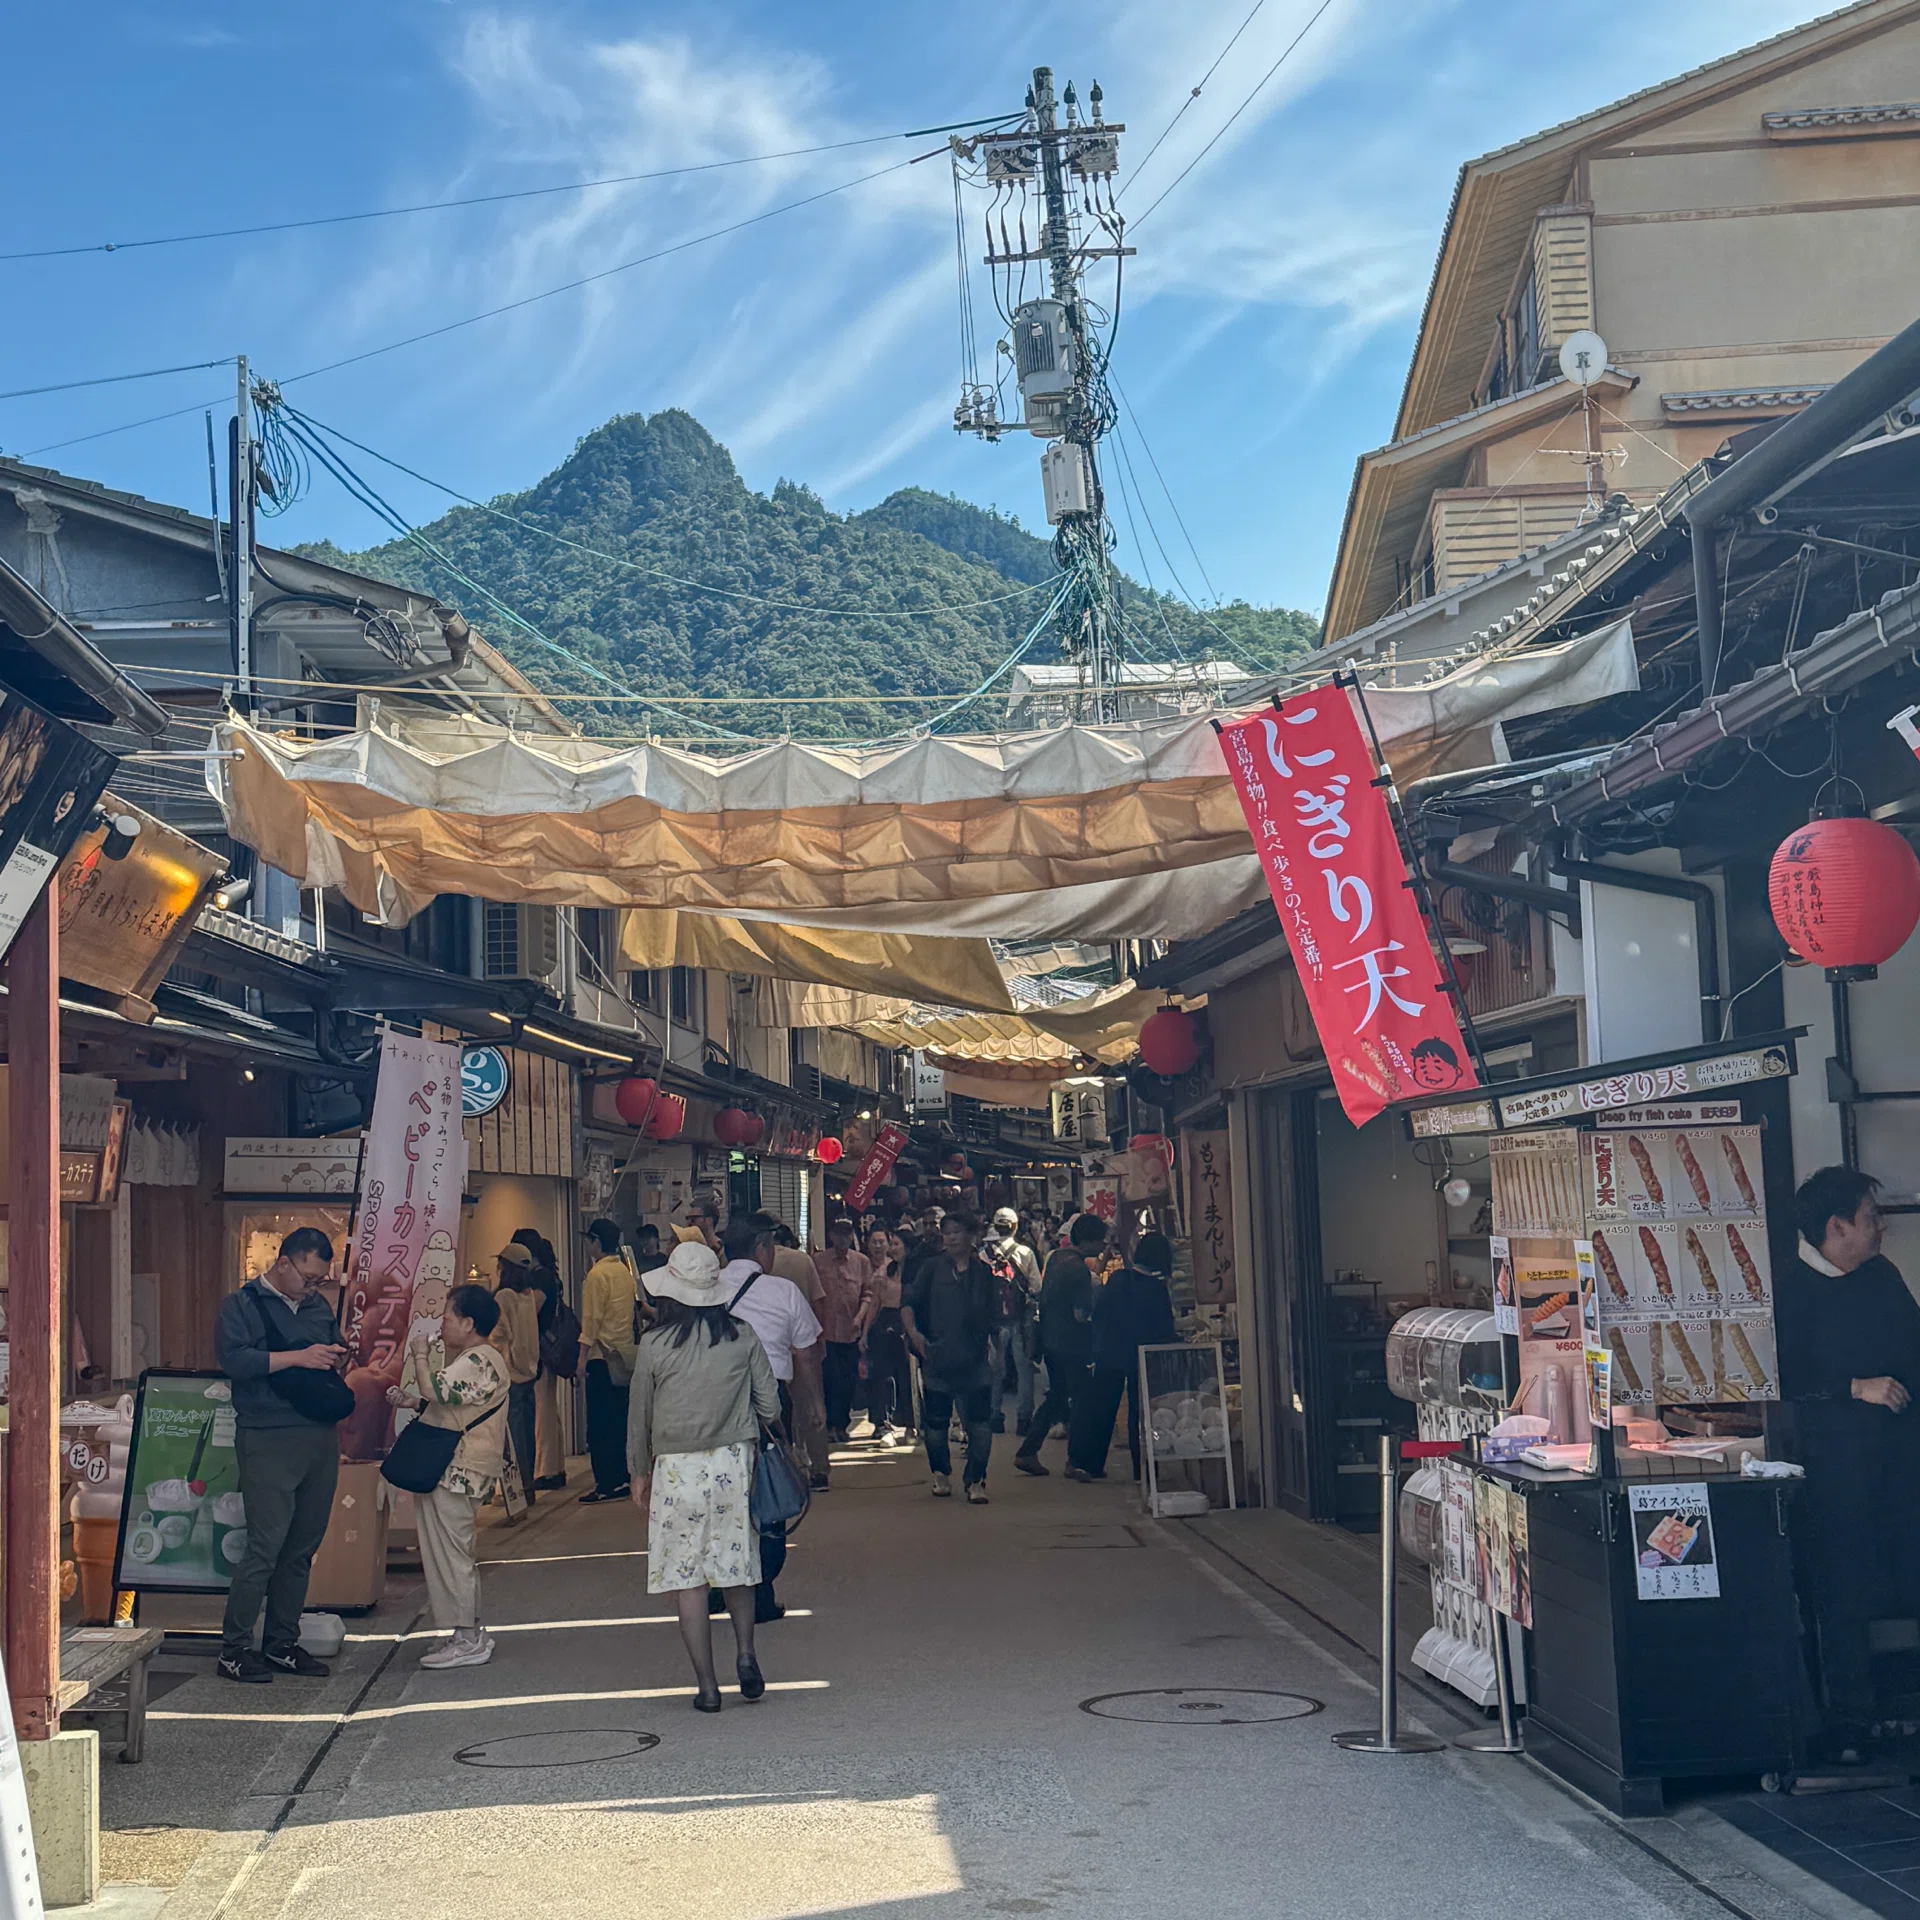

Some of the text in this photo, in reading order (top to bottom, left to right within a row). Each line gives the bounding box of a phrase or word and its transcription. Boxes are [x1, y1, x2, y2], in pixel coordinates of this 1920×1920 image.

[1258, 707, 1426, 1035] にぎり天
[1580, 1064, 1688, 1108] にぎり天
[1506, 1089, 1568, 1116] 宮島食べ歩きの
[1599, 1108, 1692, 1123] Deep fry fish cake
[1641, 1132, 1667, 1141] ¥450
[1688, 1130, 1713, 1139] ¥450
[1732, 1129, 1758, 1138] ¥450
[1594, 1136, 1616, 1207] にぎり天
[1199, 1141, 1231, 1293] もみじまんじゅう
[373, 1081, 437, 1369] ベビーカステラ
[1651, 1224, 1676, 1233] ¥450
[1740, 1221, 1765, 1230] ¥450
[1605, 1226, 1630, 1235] ¥450
[349, 1180, 384, 1356] SPONGE CAKE
[1642, 1294, 1677, 1304] いかげそ
[1684, 1323, 1709, 1331] ¥600
[1744, 1320, 1769, 1329] ¥600
[1622, 1326, 1648, 1334] ¥600
[1555, 1341, 1583, 1351] ¥600
[153, 1423, 202, 1438] メニュー
